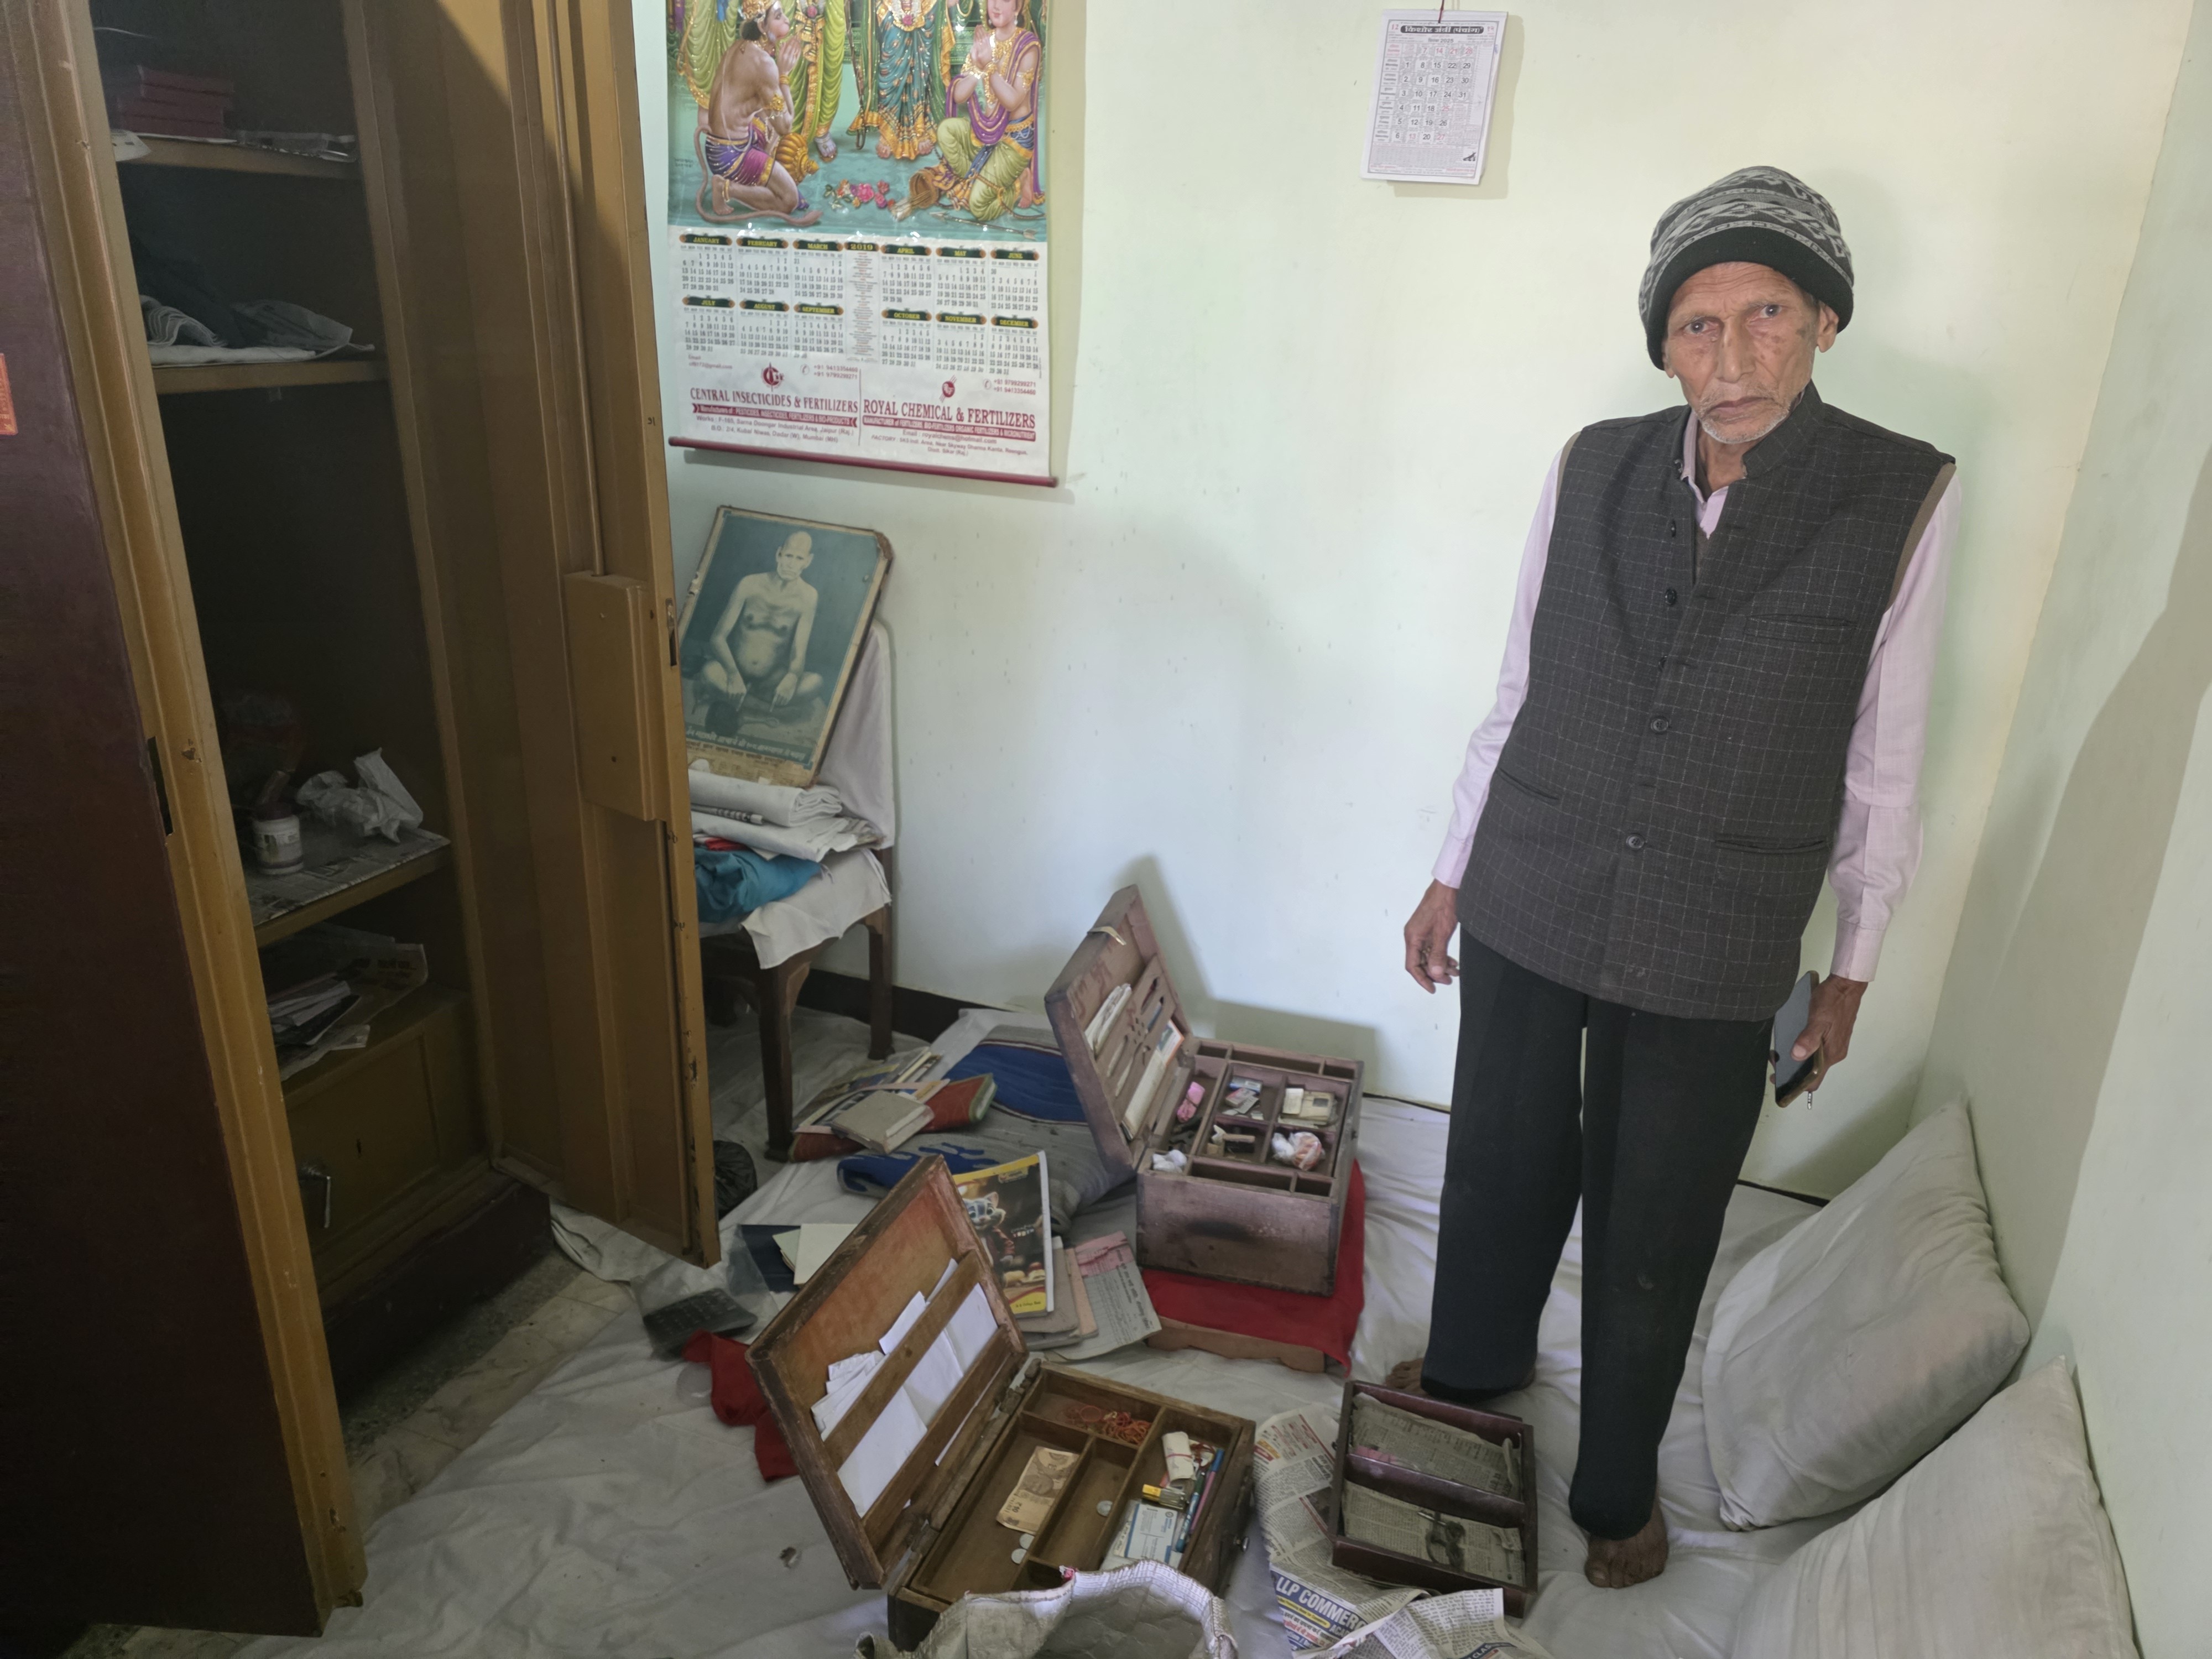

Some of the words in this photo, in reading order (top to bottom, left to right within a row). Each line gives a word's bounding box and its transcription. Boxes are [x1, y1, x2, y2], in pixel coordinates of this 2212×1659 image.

[690, 387, 729, 401] CENTRAL
[733, 390, 791, 407] INSECTICIDES
[794, 396, 801, 408] &
[804, 397, 858, 413] FERTILIZERS
[863, 399, 898, 415] ROYAL
[901, 402, 952, 421] CHEMICAL
[956, 407, 964, 422] &
[968, 408, 1035, 429] FERTILIZERS
